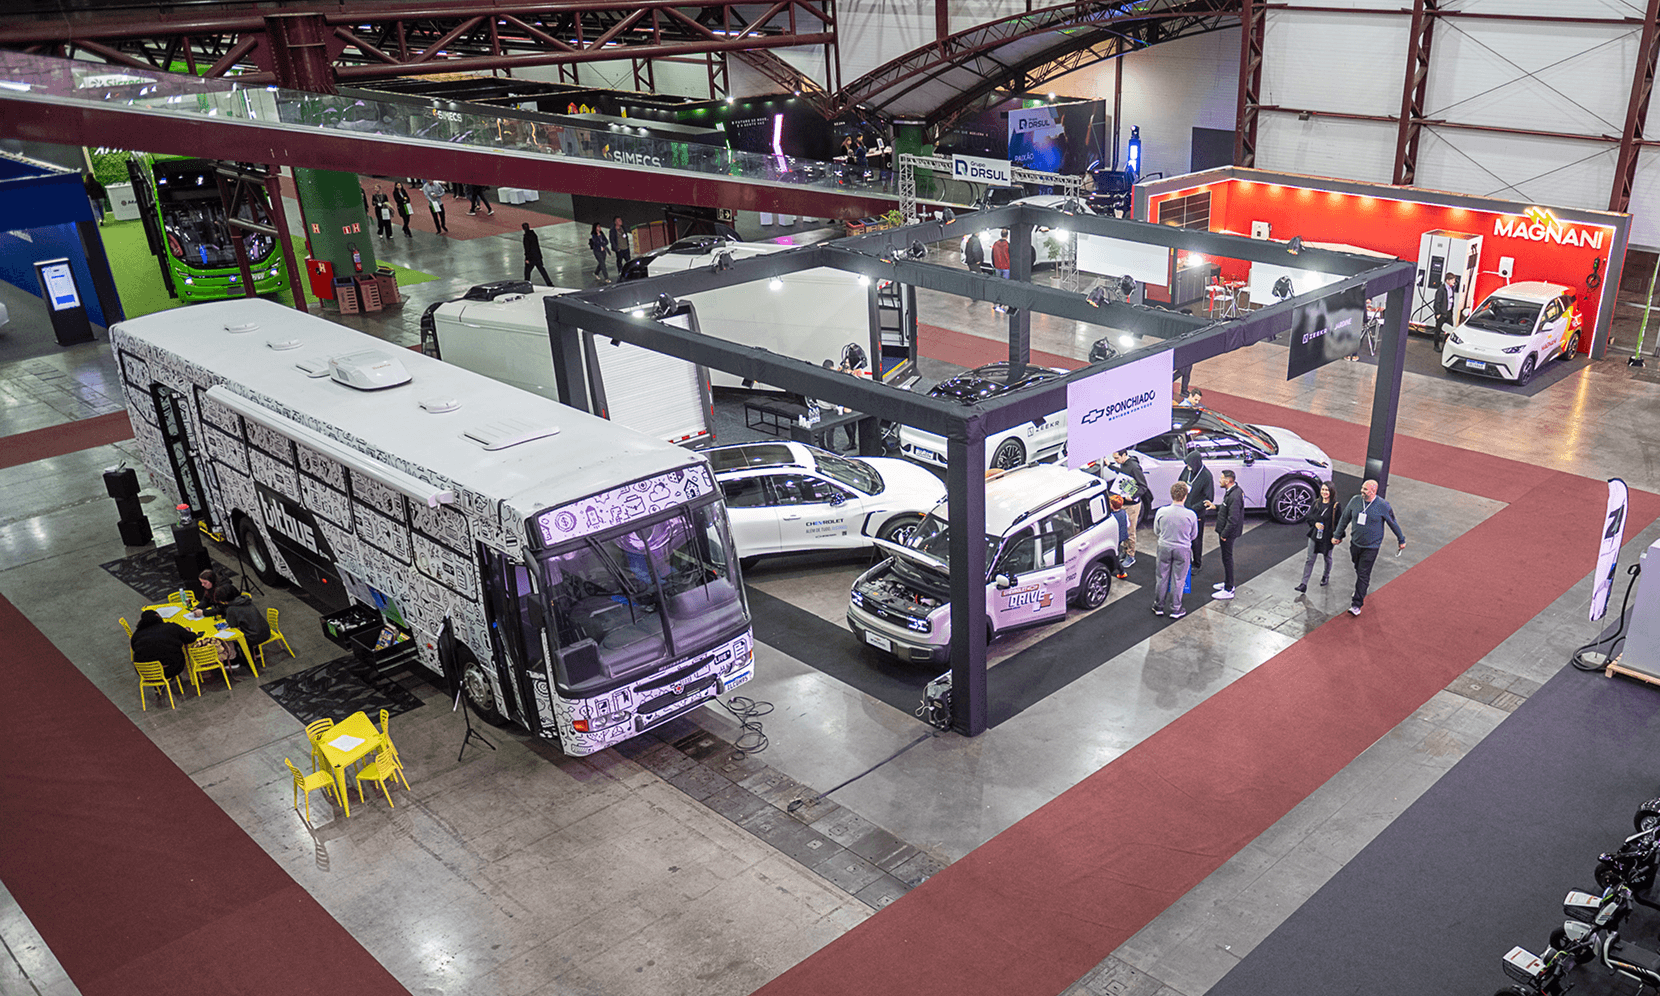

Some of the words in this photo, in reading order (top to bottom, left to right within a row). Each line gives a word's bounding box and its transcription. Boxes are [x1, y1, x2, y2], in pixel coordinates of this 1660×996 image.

[1028, 120, 1050, 129] DRSUL
[613, 150, 662, 168] SIMECS
[970, 167, 1008, 181] DRSUL
[1493, 218, 1604, 250] MAGNANI
[1105, 390, 1156, 417] SPONCHIADO
[805, 518, 844, 527] CHEVROLET
[1009, 590, 1045, 608] DRIVE
